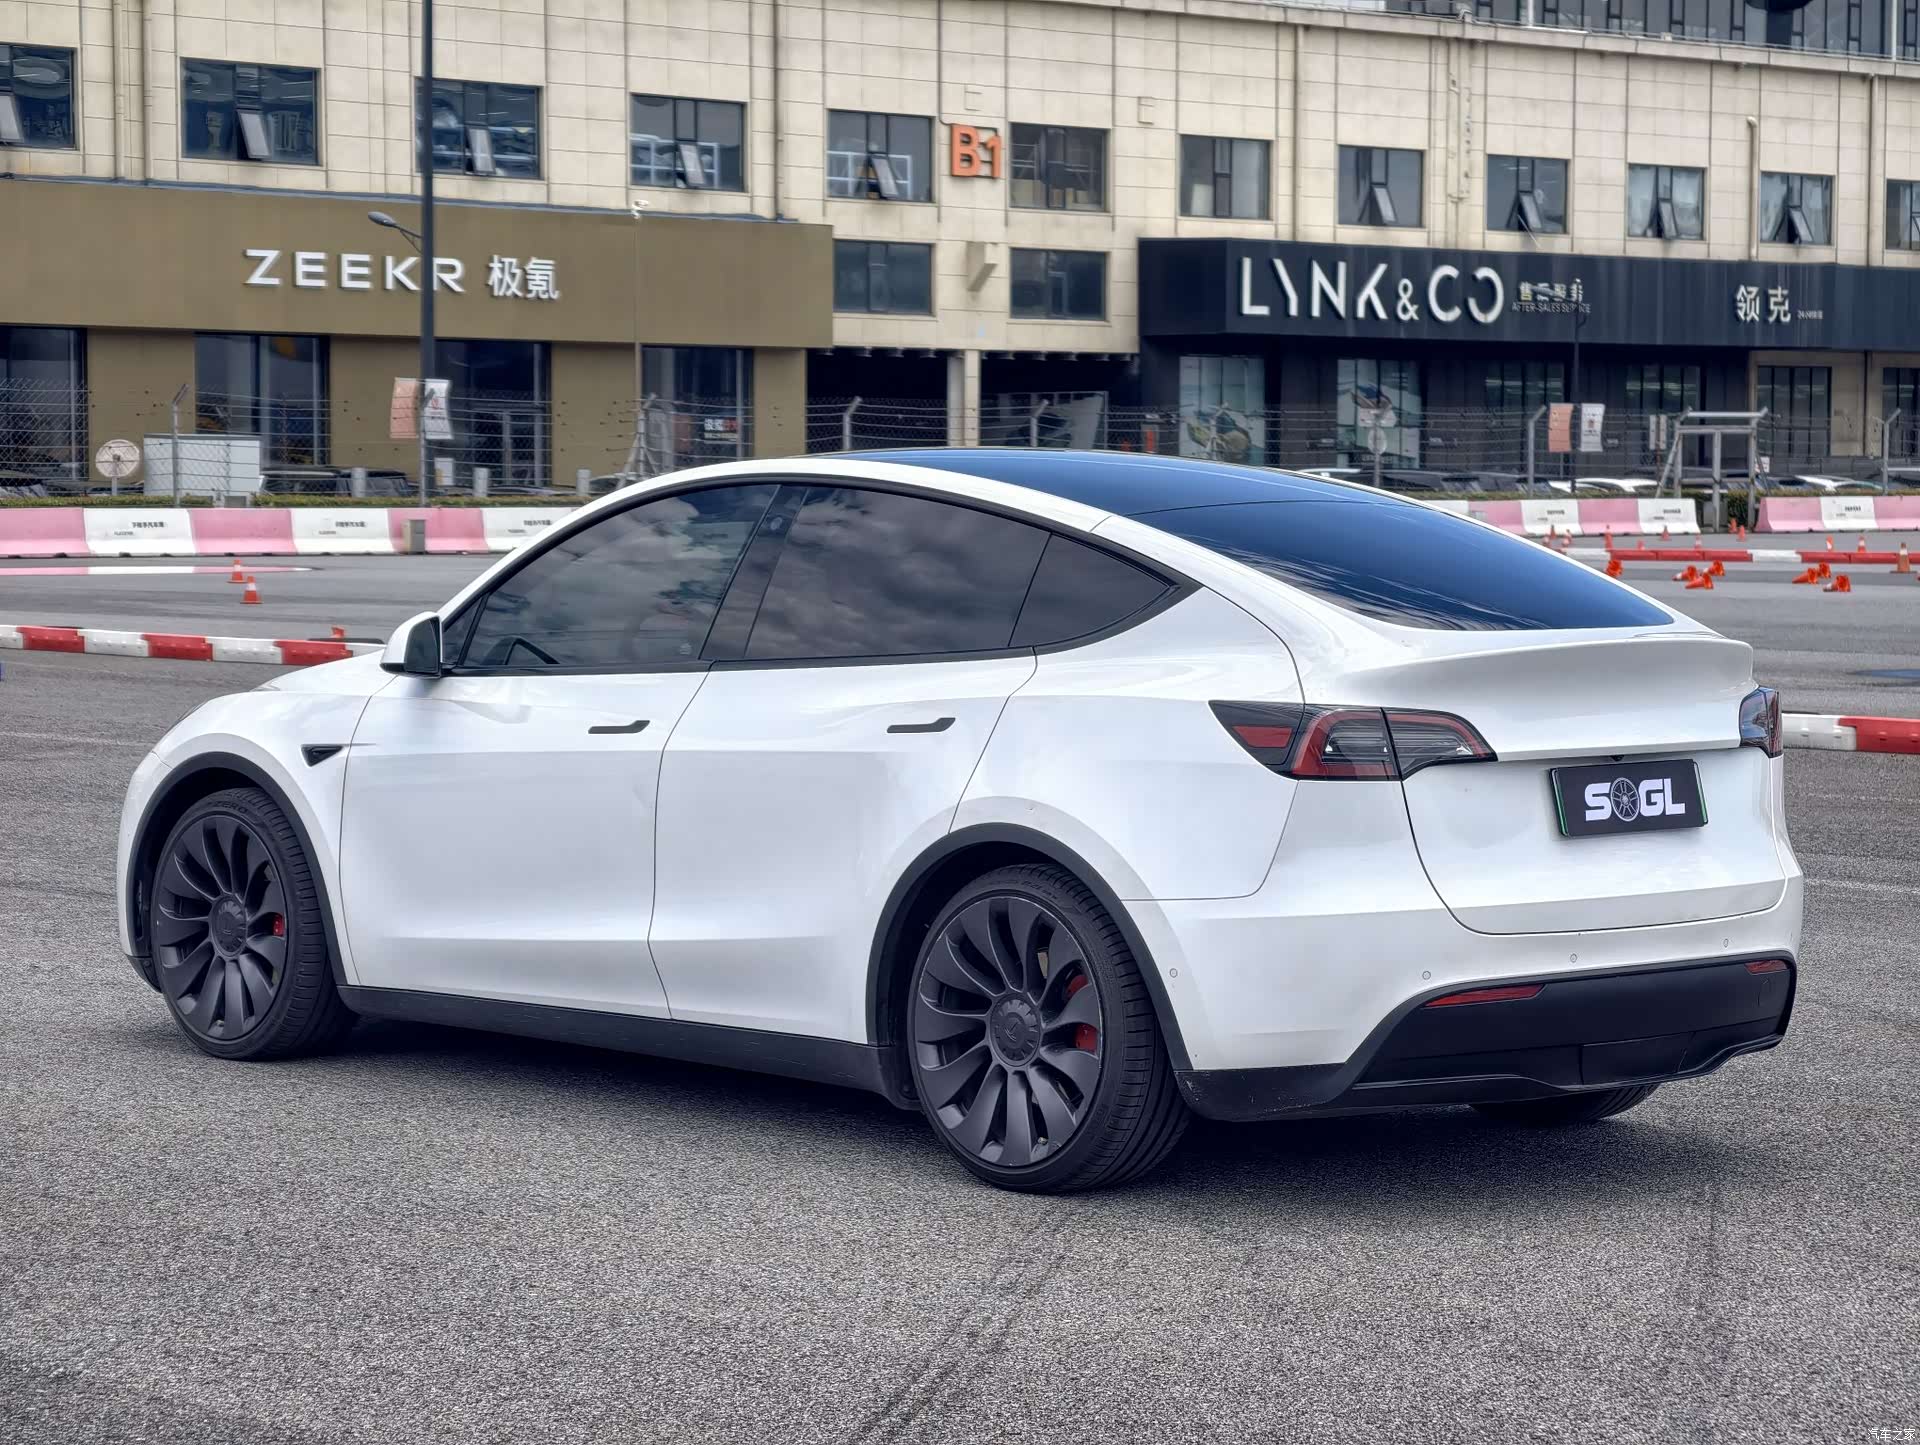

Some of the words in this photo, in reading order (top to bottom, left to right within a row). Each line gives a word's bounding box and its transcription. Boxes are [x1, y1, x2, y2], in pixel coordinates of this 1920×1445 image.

[951, 124, 1002, 179] B1
[245, 249, 466, 293] ZEEKR
[488, 254, 560, 300] 极氪
[1736, 284, 1791, 324] 领克
